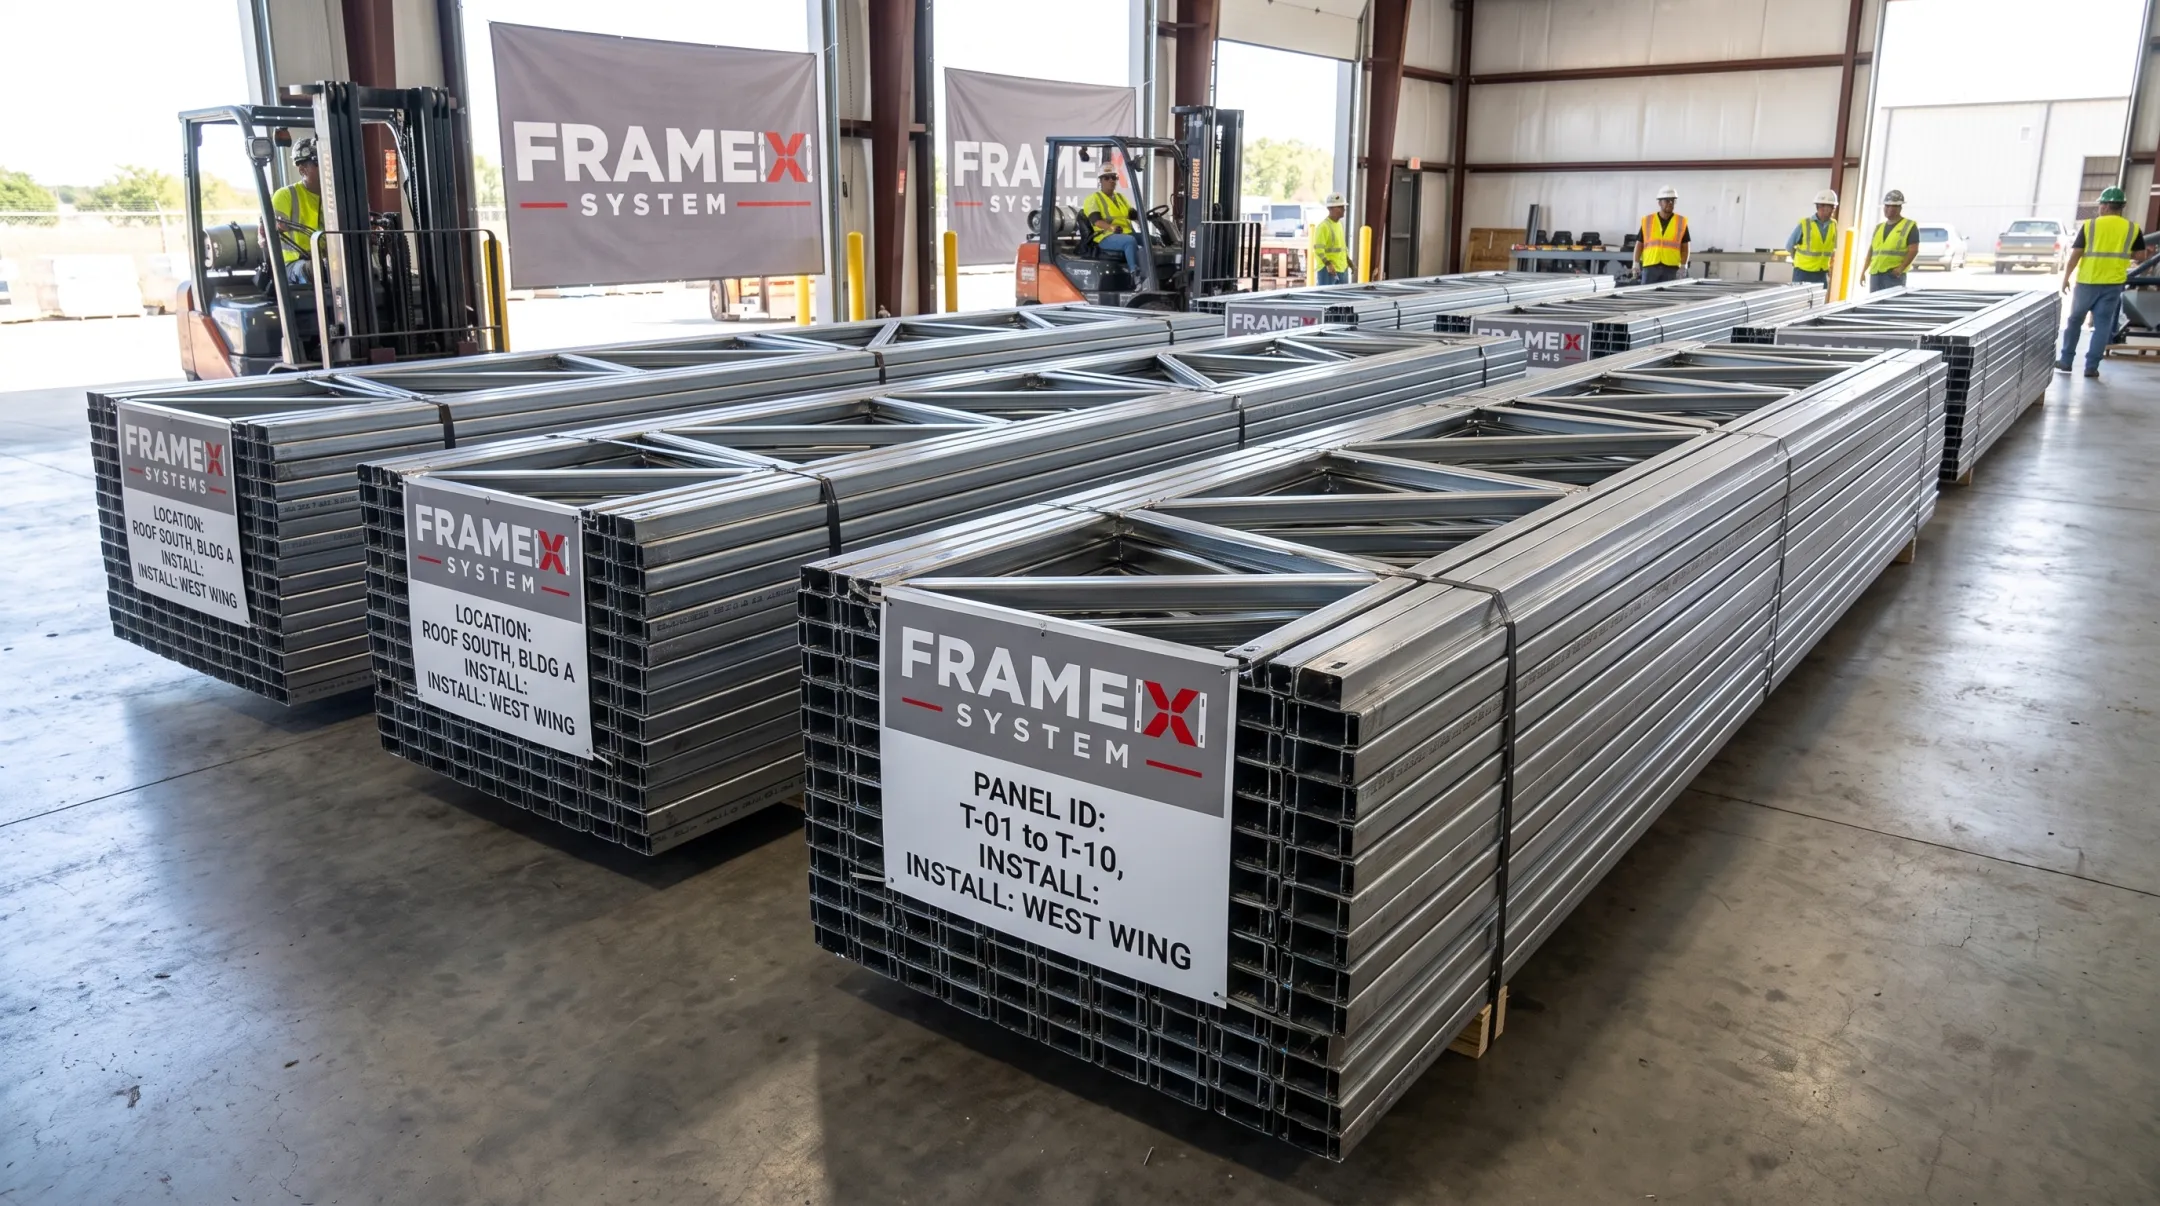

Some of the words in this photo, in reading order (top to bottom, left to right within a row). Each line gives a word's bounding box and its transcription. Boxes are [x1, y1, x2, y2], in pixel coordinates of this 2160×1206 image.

[513, 121, 813, 183] FRAMEX
[580, 193, 726, 217] SYSTEM
[989, 194, 1079, 213] SYSM
[125, 423, 226, 477] FRAMEX
[145, 466, 207, 495] SYSTEMS
[132, 519, 157, 540] ROOF
[159, 528, 196, 555] SOUTH,
[196, 538, 224, 561] BLDG
[226, 547, 235, 564] A
[153, 505, 204, 533] LOCATION:
[415, 503, 570, 576] FRAMEX
[137, 562, 178, 589] INSTALL:
[179, 576, 207, 599] WEST
[209, 585, 238, 609] WING
[161, 550, 205, 577] INSTALL:
[447, 556, 535, 595] SYSTEM
[455, 603, 532, 643] LOCATION:
[422, 620, 459, 647] ROOF
[462, 632, 515, 669] SOUTH,
[518, 648, 559, 678] BLDG
[563, 662, 576, 684] A
[464, 657, 529, 696] INSTALL:
[427, 670, 487, 708] INSTALL:
[489, 691, 530, 722] WEST
[533, 705, 576, 736] WING
[901, 625, 1208, 749] FRAMEX
[956, 702, 1129, 769] SYSTEM
[974, 770, 1061, 821] PANEL
[1069, 797, 1106, 833] ID:
[959, 802, 1011, 842] T-01
[1022, 823, 1049, 852] to
[1055, 830, 1124, 881] T-10,
[979, 842, 1099, 905] INSTALL:
[906, 851, 1014, 912] INSTALL:
[1022, 891, 1101, 941] WEST
[1108, 920, 1192, 970] WING
